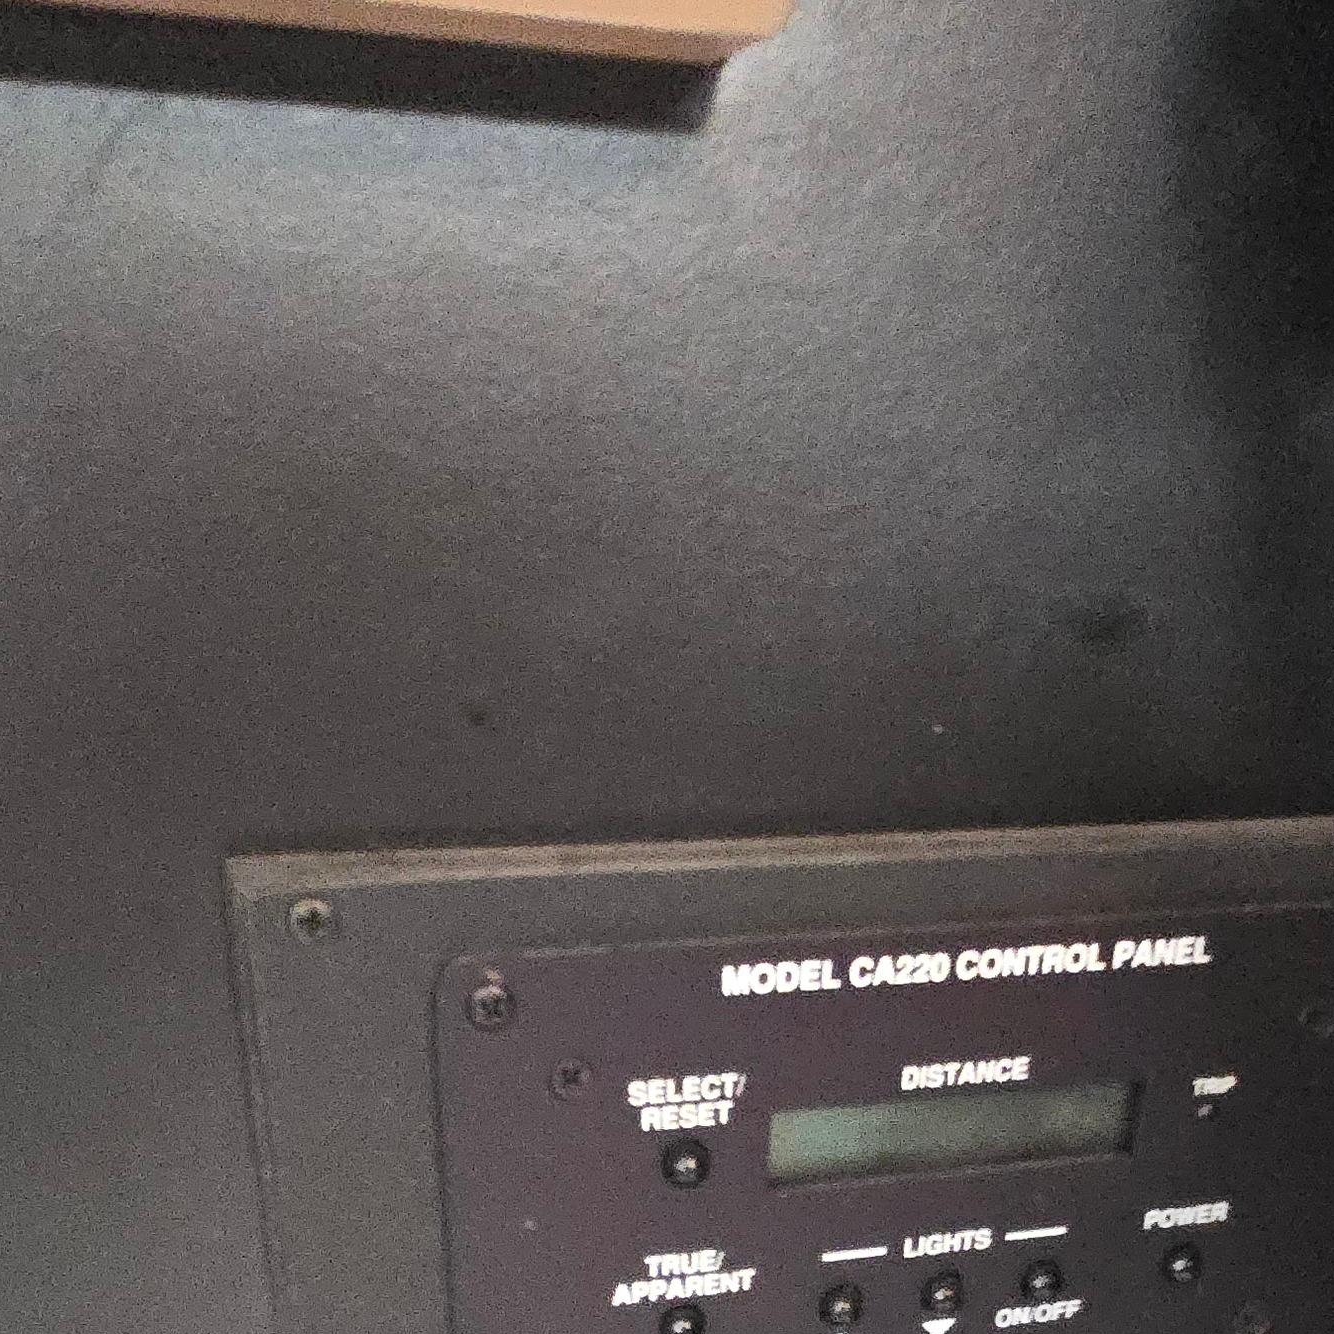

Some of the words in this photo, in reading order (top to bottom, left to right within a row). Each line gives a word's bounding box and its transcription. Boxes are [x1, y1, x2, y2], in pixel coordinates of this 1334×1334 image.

[720, 959, 841, 997] MODEL
[849, 952, 951, 988] CA220
[956, 943, 1106, 981] CONTROL
[1112, 936, 1213, 969] PANEL
[901, 1056, 1031, 1091] DISTANCE
[640, 1099, 735, 1132] RESET
[1143, 1200, 1230, 1230] POWER
[903, 1228, 993, 1259] LIGHTS
[611, 1267, 757, 1307] APPARENT
